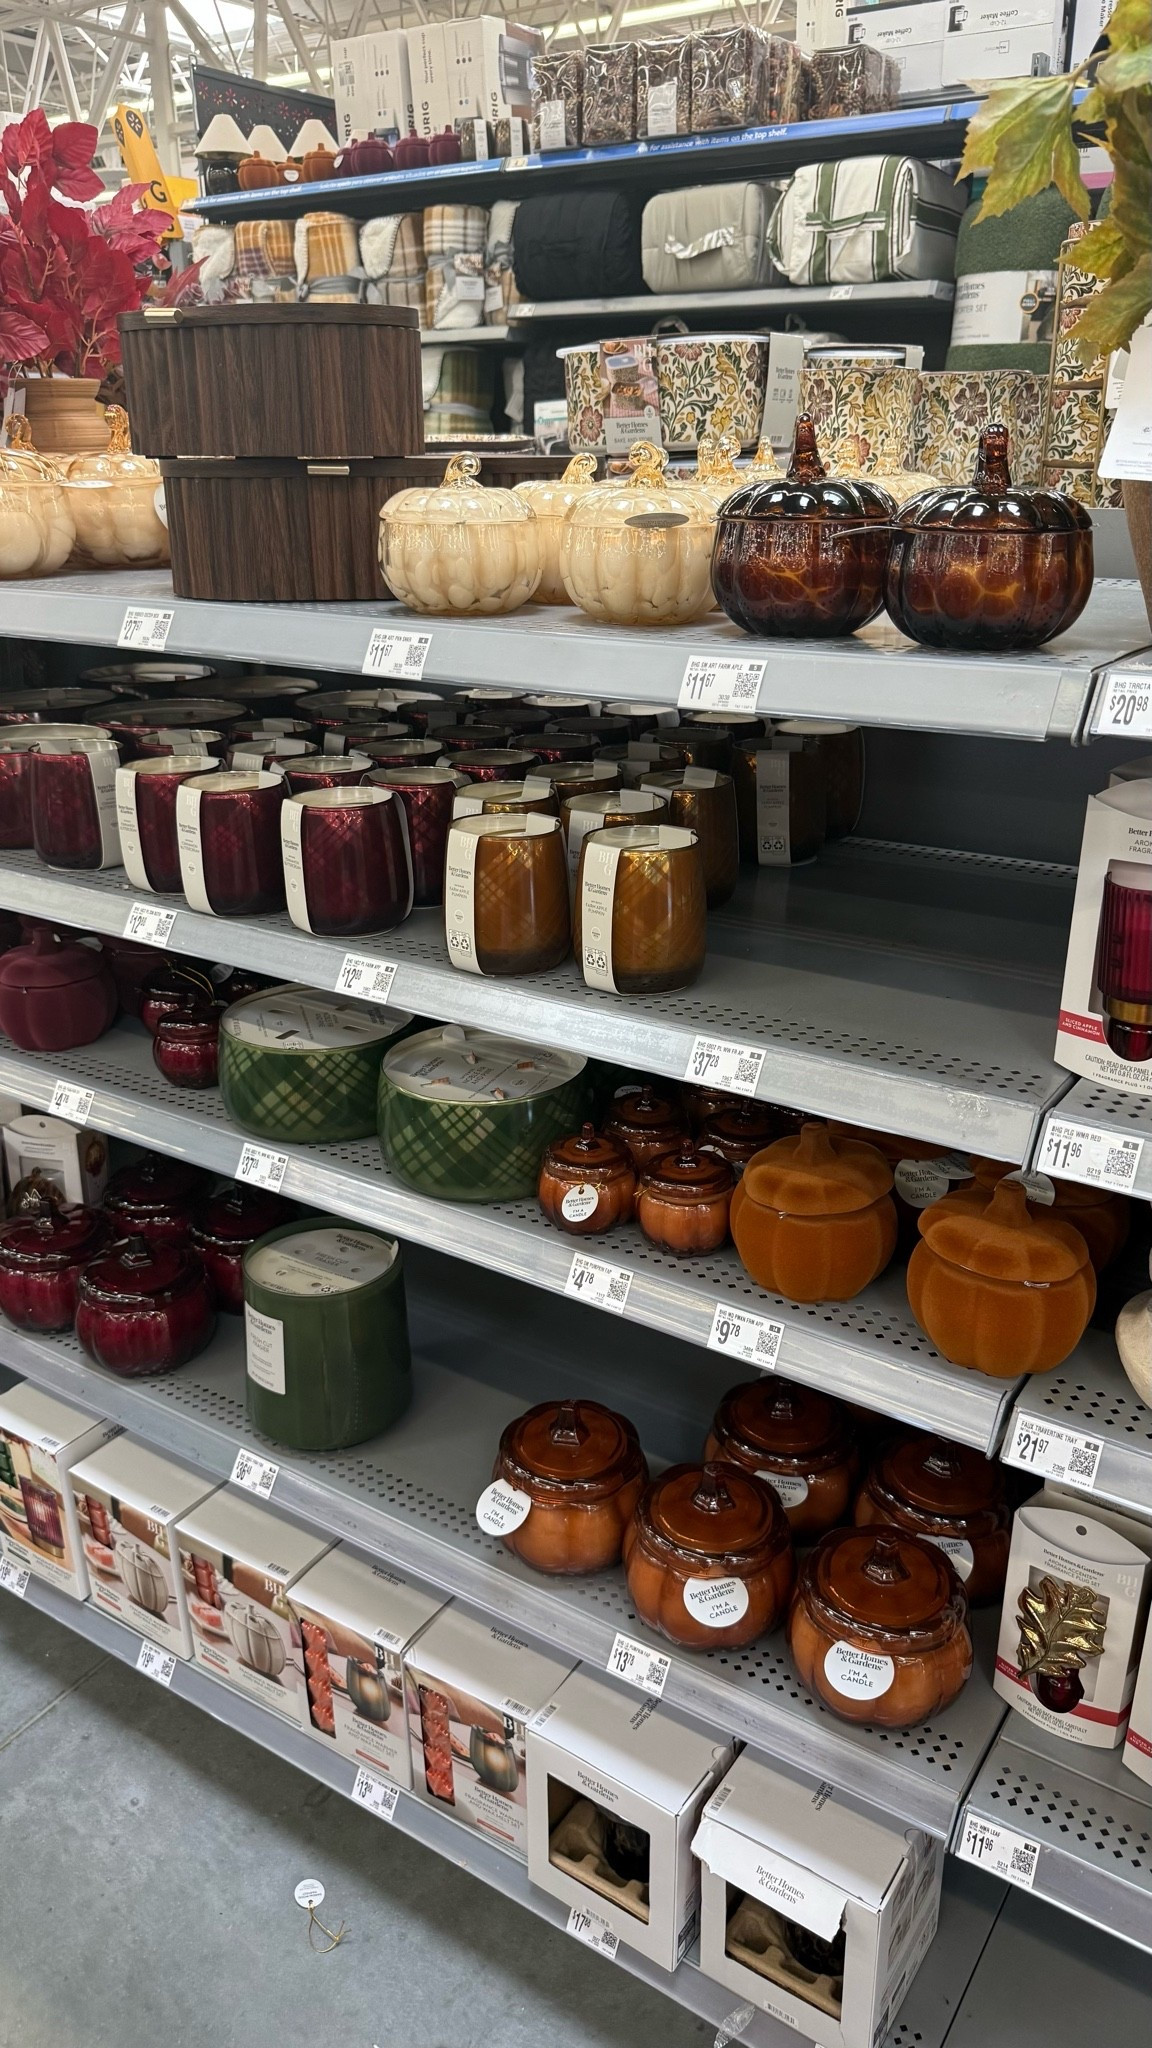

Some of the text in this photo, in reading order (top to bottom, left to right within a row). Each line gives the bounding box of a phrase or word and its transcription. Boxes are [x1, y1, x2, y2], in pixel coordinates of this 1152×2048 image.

[980, 9, 1019, 21] Coffee Maker
[877, 27, 912, 38] Coffee Maker
[650, 142, 660, 151] for
[661, 140, 694, 150] assistance
[710, 136, 730, 144] items
[741, 132, 754, 141] the
[754, 131, 767, 140] top
[768, 127, 788, 137] shelf.
[686, 673, 716, 700] $1167
[1109, 694, 1149, 725] $2098
[1128, 827, 1148, 837] Better
[599, 851, 614, 864] BH
[448, 865, 471, 876] Better Homes
[604, 864, 612, 876] G
[585, 881, 611, 892] Better Homes
[591, 888, 608, 896] Gardens
[1065, 1017, 1098, 1031] SLICED APPLE
[1072, 1024, 1100, 1036] CINNAMON
[693, 1051, 720, 1077] $3728
[1085, 1054, 1150, 1076] CAUTION: READ BACK PANEL
[1100, 1065, 1109, 1073] NET
[1095, 1073, 1123, 1084] FRAGRANCE
[1051, 1126, 1102, 1142] BHG PLG WMR RED
[900, 1170, 918, 1178] Better
[910, 1174, 938, 1182] Gardens
[336, 1233, 374, 1250] Better Homes
[572, 1268, 595, 1291] $478
[715, 1320, 741, 1344] $978
[1021, 1420, 1078, 1444] FAUX TRAVERTINE TRAY
[1017, 1432, 1049, 1462] $2197
[777, 1479, 802, 1487] Homes
[491, 1487, 524, 1512] Better Homes
[496, 1498, 519, 1515] Gardens
[483, 1512, 505, 1528] CANDLE
[491, 1509, 499, 1518] I'M
[1043, 1549, 1104, 1577] Better Homes Gardens
[1048, 1558, 1068, 1570] AROMA
[372, 1564, 406, 1585] Better Homes
[377, 1571, 399, 1586] Gardens
[1044, 1561, 1075, 1578] FRAGRANCE
[1075, 1575, 1090, 1584] PLUG
[1117, 1573, 1138, 1586] BH
[264, 1578, 283, 1596] BH
[689, 1580, 736, 1600] Better Homes
[704, 1587, 735, 1602] Gardens
[1124, 1587, 1135, 1598] G
[709, 1605, 739, 1619] CANDLE
[711, 1603, 723, 1611] I'M
[490, 1626, 529, 1648] Better Homes
[497, 1635, 521, 1650] Gardens
[836, 1647, 889, 1666] Better Homes
[848, 1657, 883, 1671] Gardens
[840, 1674, 874, 1688] CANDLE
[629, 1703, 650, 1724] Gardens
[632, 1713, 651, 1730] Homes
[352, 1716, 388, 1739] Better Homes
[1064, 1720, 1088, 1734] CAREFULLY
[577, 1771, 619, 1800] Better Homes
[588, 1783, 614, 1803] Gardens
[474, 1785, 513, 1810] Better Homes
[483, 1795, 509, 1812] Gardens
[815, 1790, 832, 1812] Homes
[465, 1792, 524, 1826] FRAGRANCE WARMER
[970, 1820, 1001, 1837] BHG LEAF
[966, 1830, 994, 1858] $1196
[756, 1865, 805, 1900] Better Homes
[765, 1880, 797, 1904] Gardens
